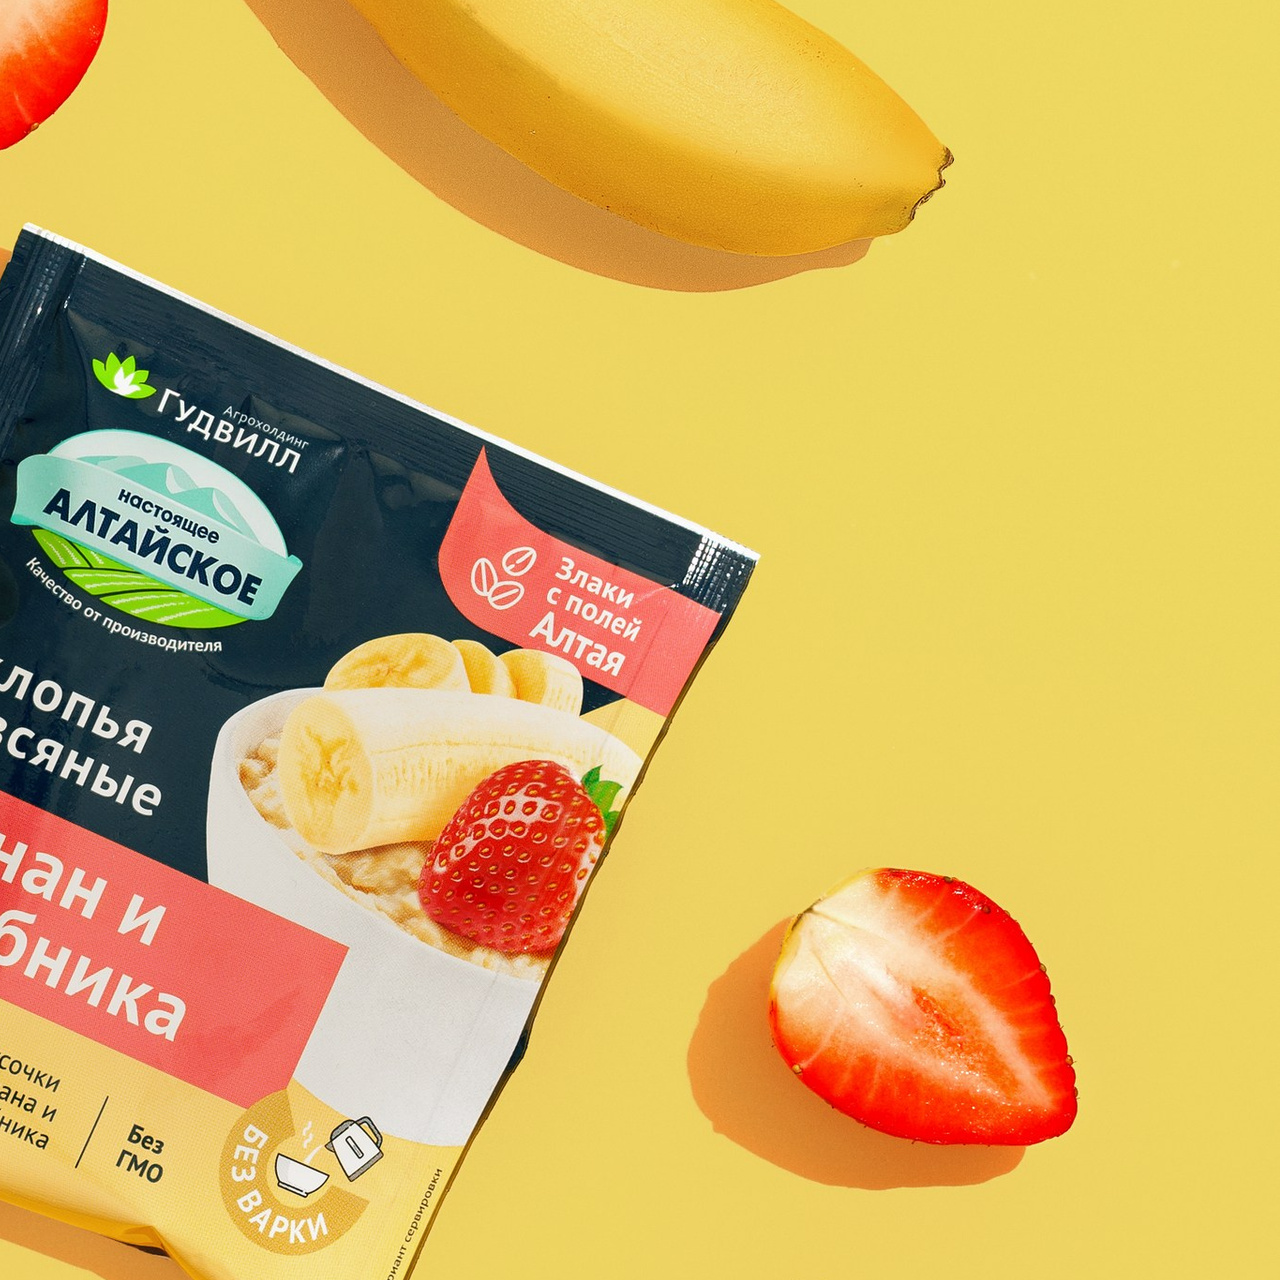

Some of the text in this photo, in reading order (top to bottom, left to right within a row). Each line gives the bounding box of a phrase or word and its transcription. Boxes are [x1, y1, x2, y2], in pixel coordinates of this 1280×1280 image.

[222, 405, 309, 450] Агрохолдинг
[117, 488, 220, 544] настоящее
[43, 488, 263, 606] АЛТАЙСКОЕ
[25, 557, 222, 652] Качество от производителя
[554, 556, 635, 609] Злаки
[547, 587, 643, 642] с полей
[528, 611, 626, 677] Алтая
[117, 894, 167, 947] и
[41, 1105, 57, 1123] и
[127, 1124, 165, 1155] Без
[115, 1149, 164, 1184] ГМО
[231, 1124, 329, 1244] БЕЗ ВАРКИ
[405, 1168, 443, 1243] сервировки
